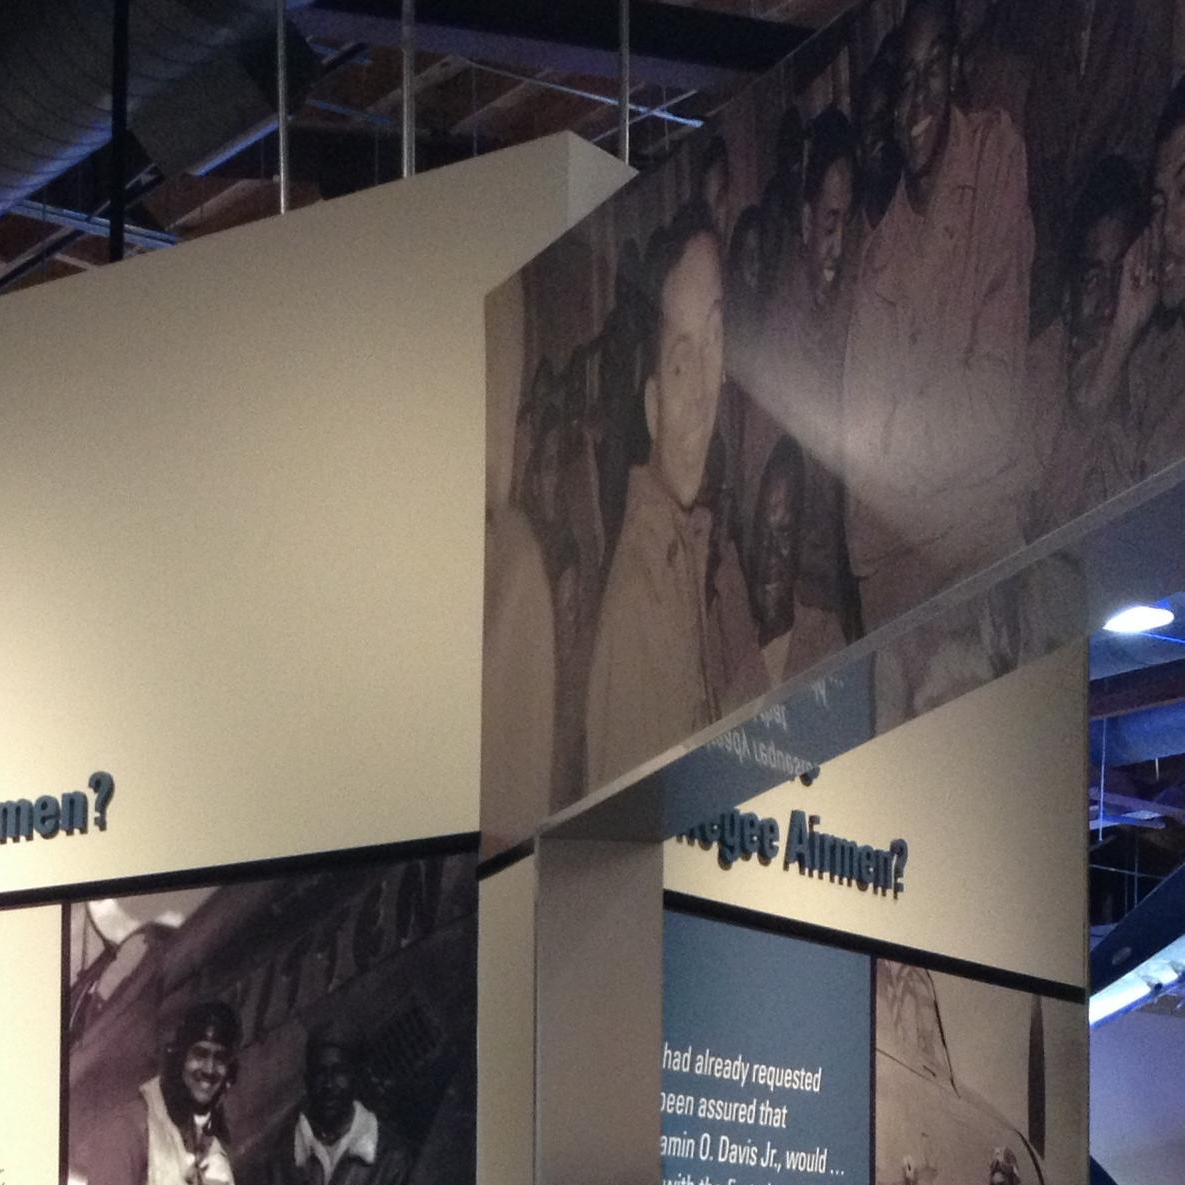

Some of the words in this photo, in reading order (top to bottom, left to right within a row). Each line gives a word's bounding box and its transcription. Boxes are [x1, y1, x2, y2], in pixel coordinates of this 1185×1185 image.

[783, 809, 908, 899] Airmen?
[662, 1043, 691, 1072] had
[694, 1049, 749, 1087] already
[751, 1064, 821, 1092] requested
[697, 1097, 756, 1123] assured
[758, 1100, 787, 1128] that
